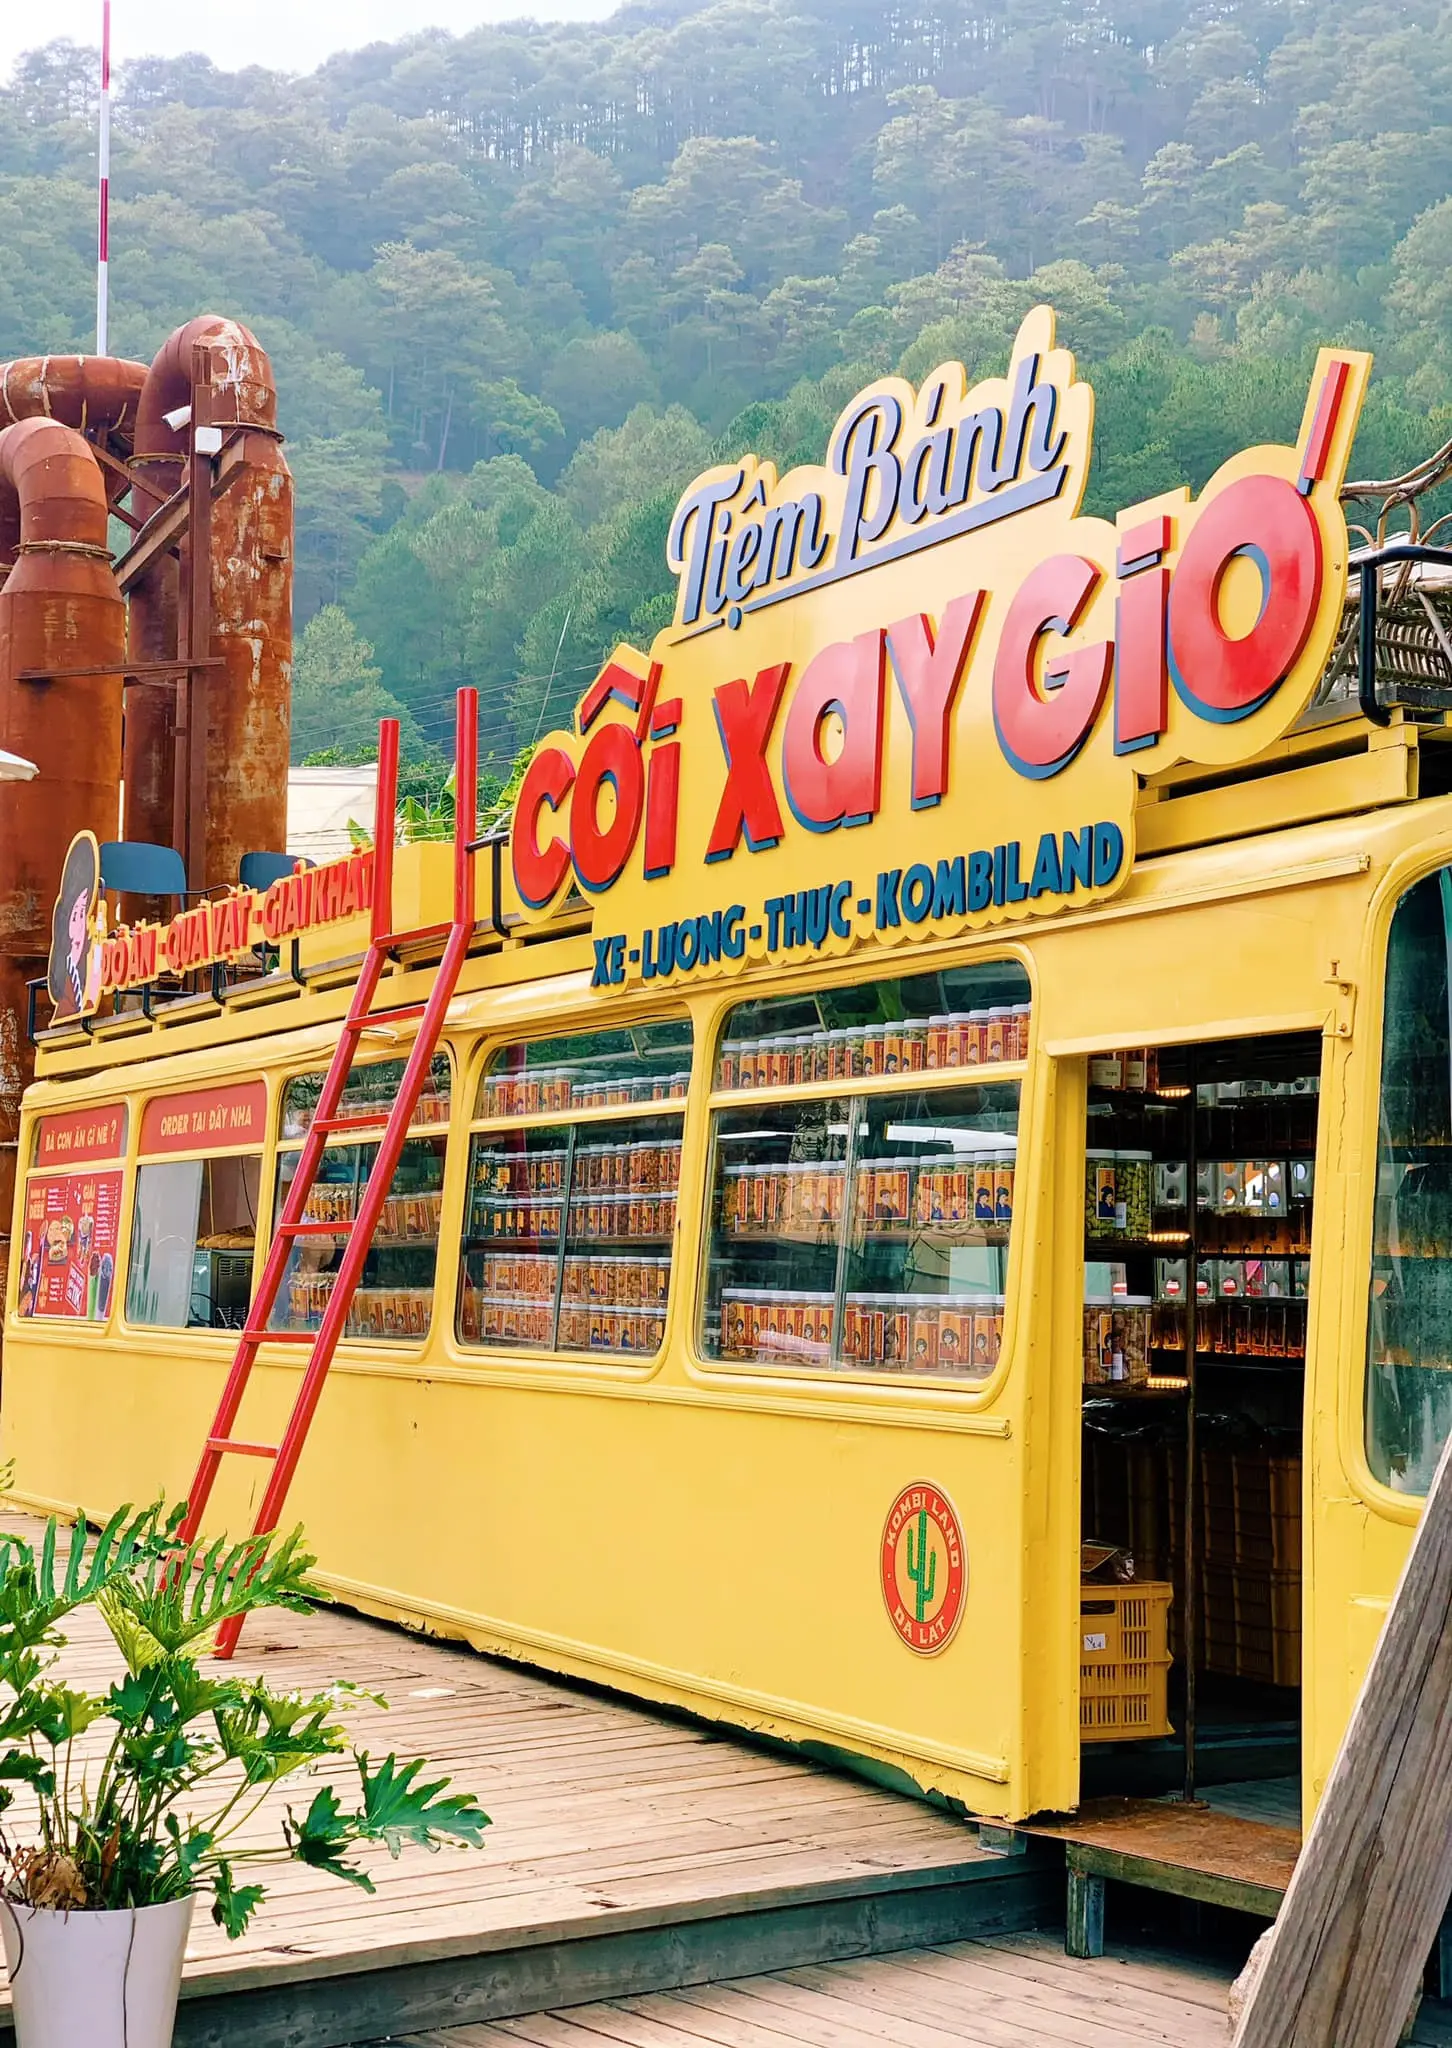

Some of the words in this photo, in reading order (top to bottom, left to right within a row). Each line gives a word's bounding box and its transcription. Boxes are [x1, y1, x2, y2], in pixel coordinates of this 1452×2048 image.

[671, 470, 829, 630] Tiệm
[833, 353, 1068, 562] Bánh
[161, 1114, 189, 1137] ORDER
[192, 1111, 206, 1134] TẠI
[208, 1104, 229, 1131] ĐÂY
[230, 1105, 252, 1128] NHA
[57, 1131, 73, 1151] CON
